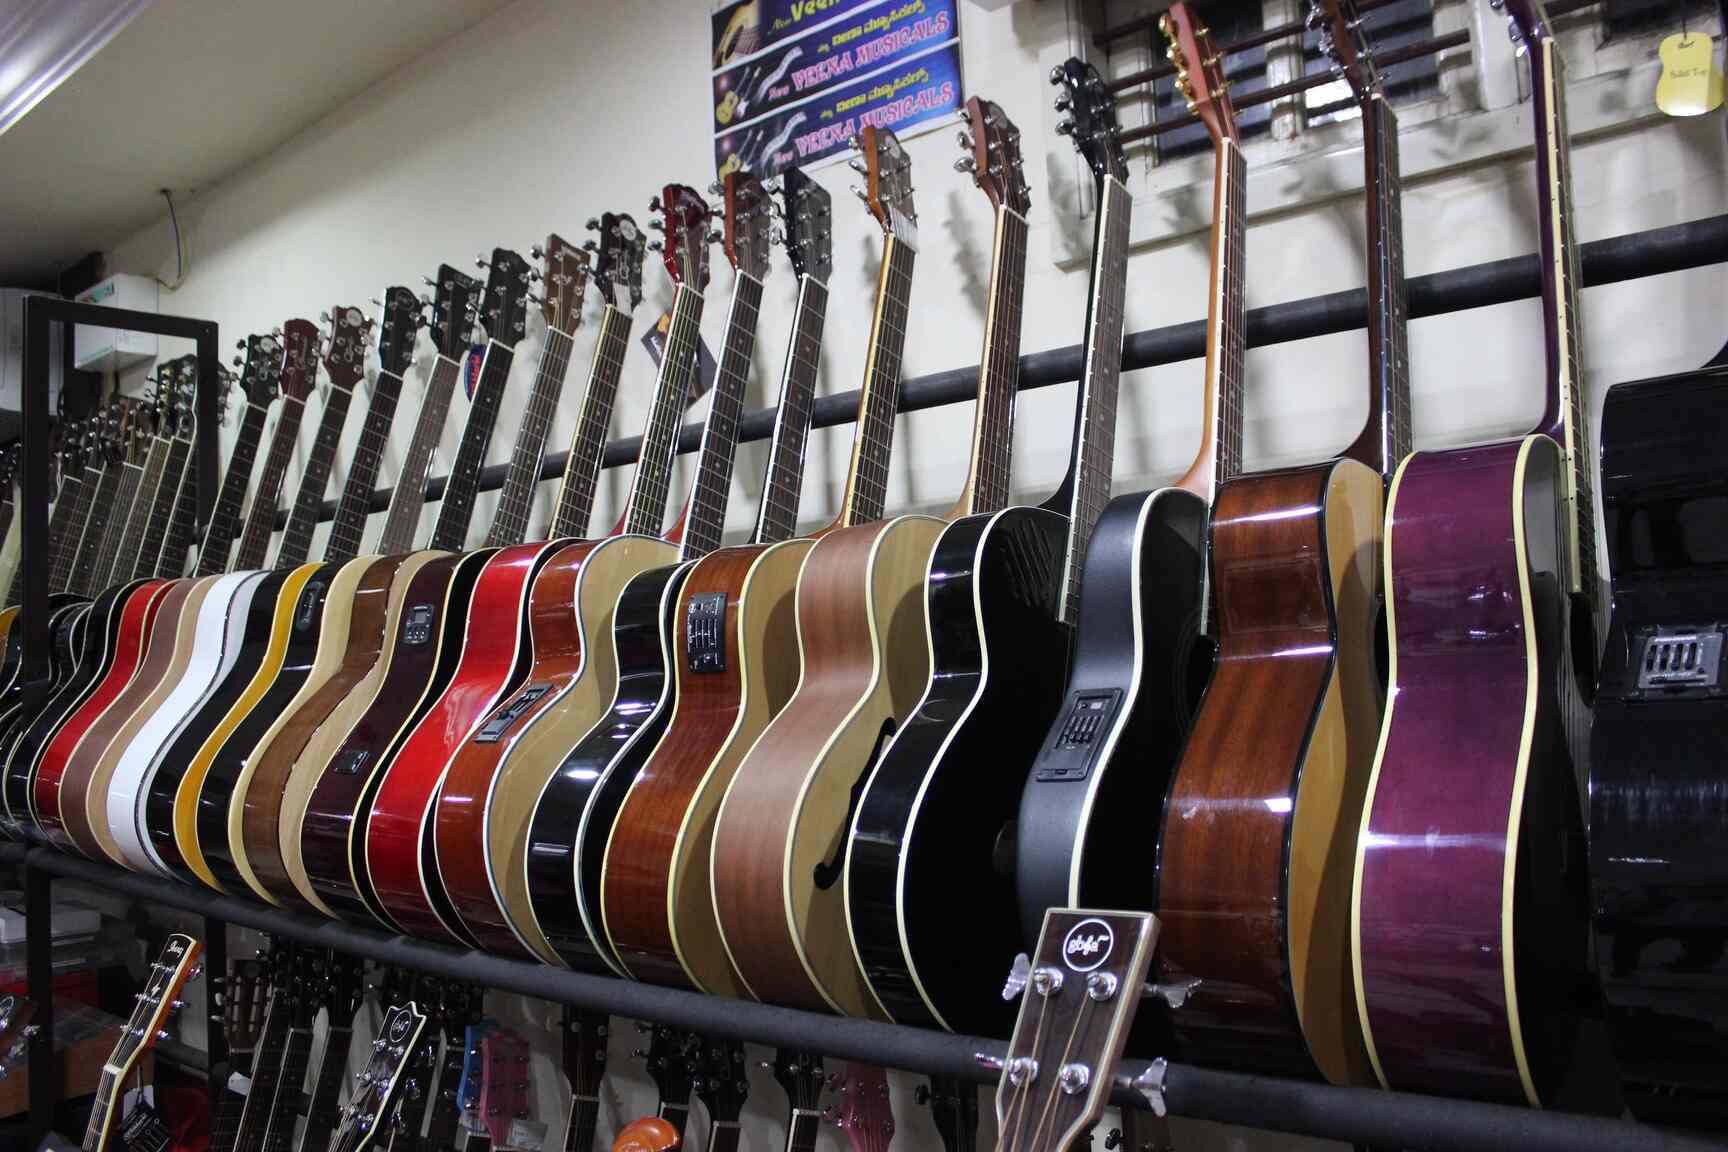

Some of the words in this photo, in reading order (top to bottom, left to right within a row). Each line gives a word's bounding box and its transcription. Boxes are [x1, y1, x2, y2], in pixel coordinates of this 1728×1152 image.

[791, 54, 854, 91] VEENA
[855, 10, 951, 66] MUSICALS
[793, 117, 856, 156] VEENA
[858, 80, 954, 134] MUSICALS
